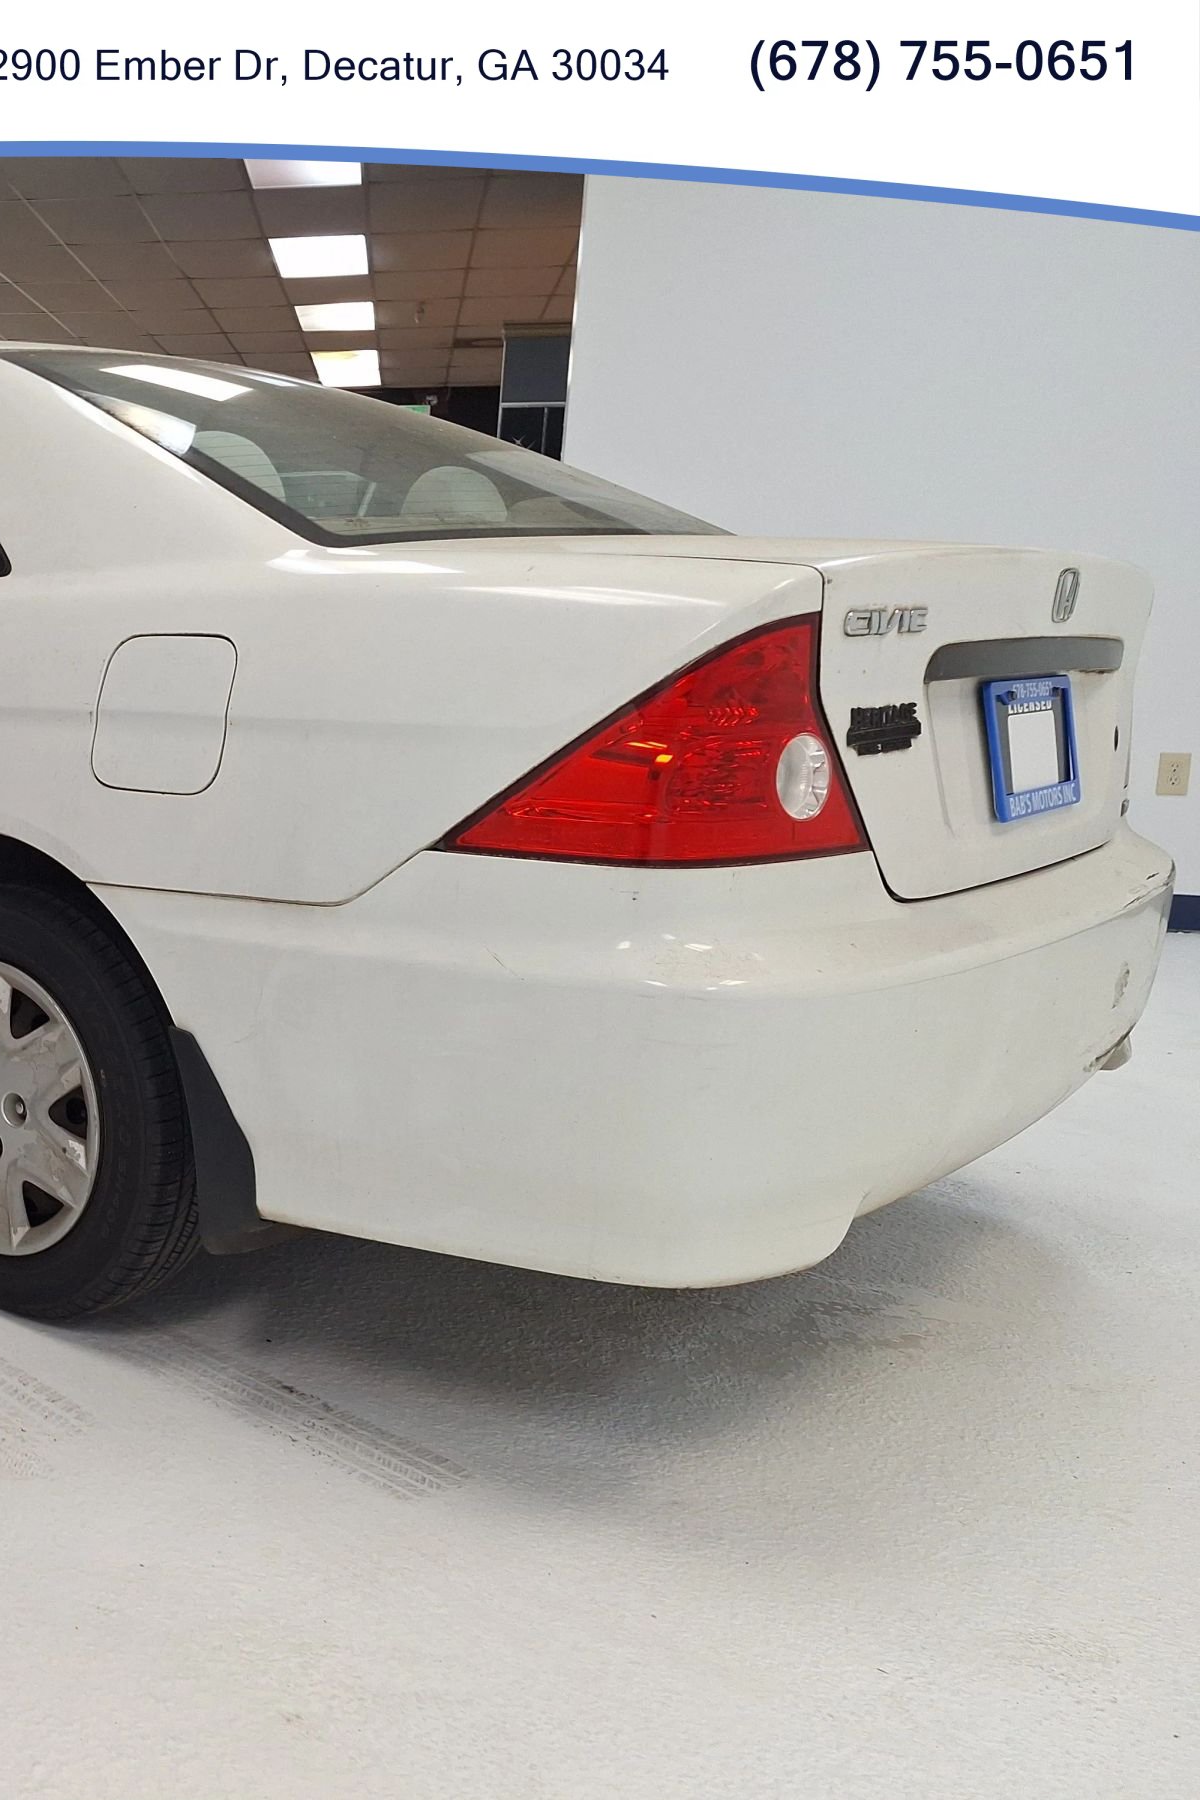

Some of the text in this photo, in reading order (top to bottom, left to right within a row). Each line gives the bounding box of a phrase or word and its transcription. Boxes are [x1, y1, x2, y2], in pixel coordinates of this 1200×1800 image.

[843, 607, 929, 637] CIVIC
[1009, 782, 1077, 817] BAB'S MOTORS INC
